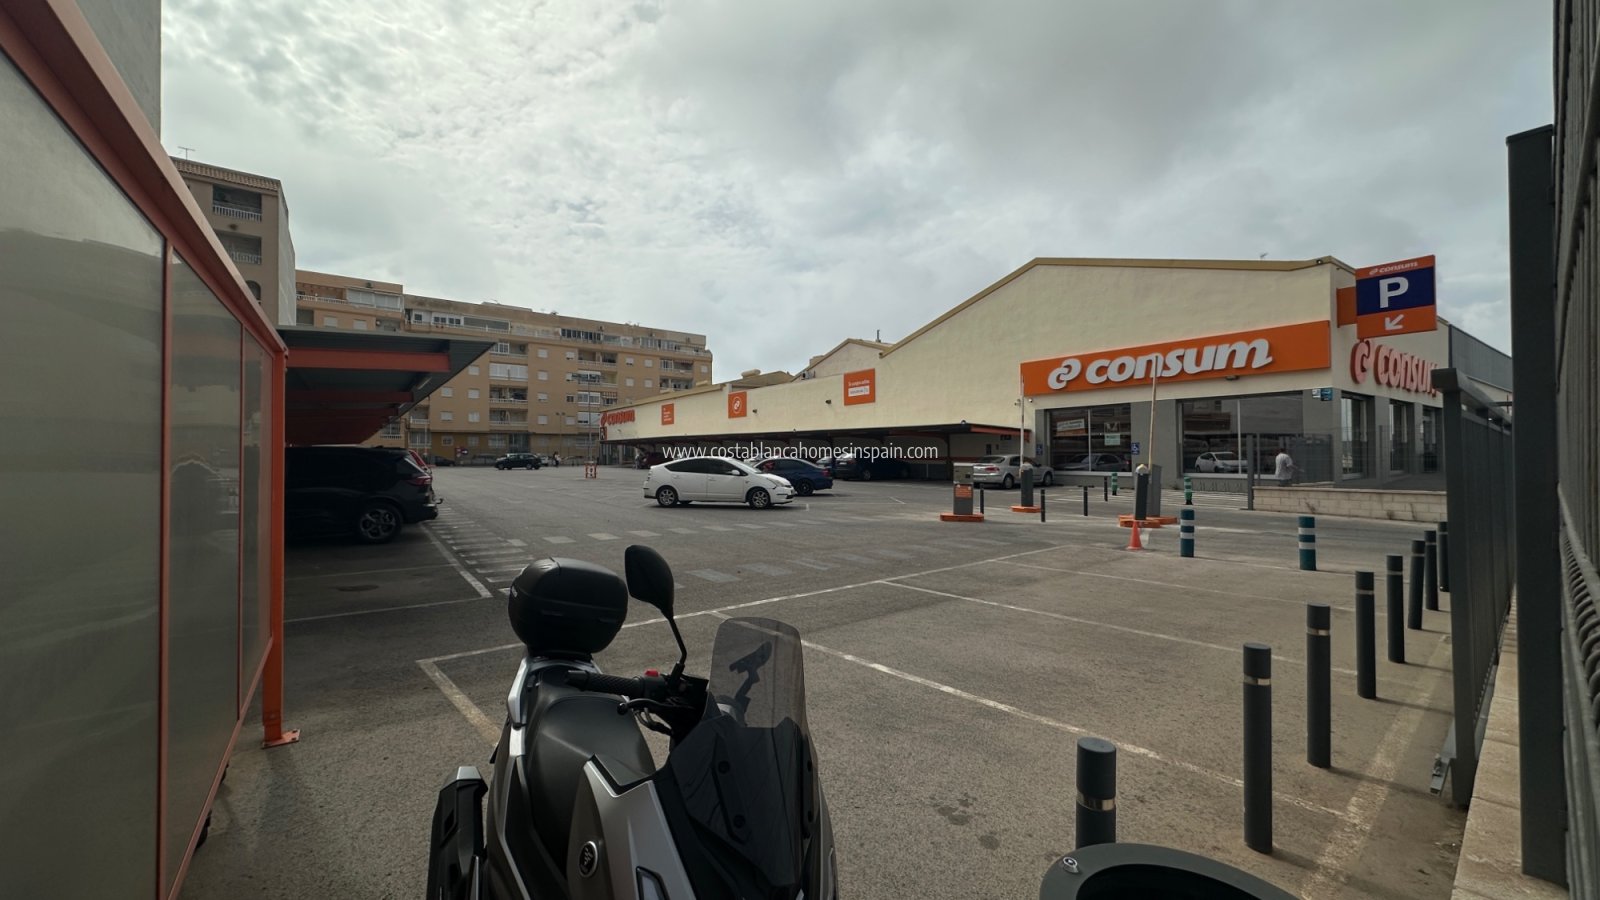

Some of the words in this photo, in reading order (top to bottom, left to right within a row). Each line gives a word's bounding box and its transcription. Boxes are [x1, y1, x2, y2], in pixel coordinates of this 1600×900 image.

[1379, 261, 1419, 273] consum
[1379, 276, 1409, 308] P
[1085, 338, 1273, 384] consum
